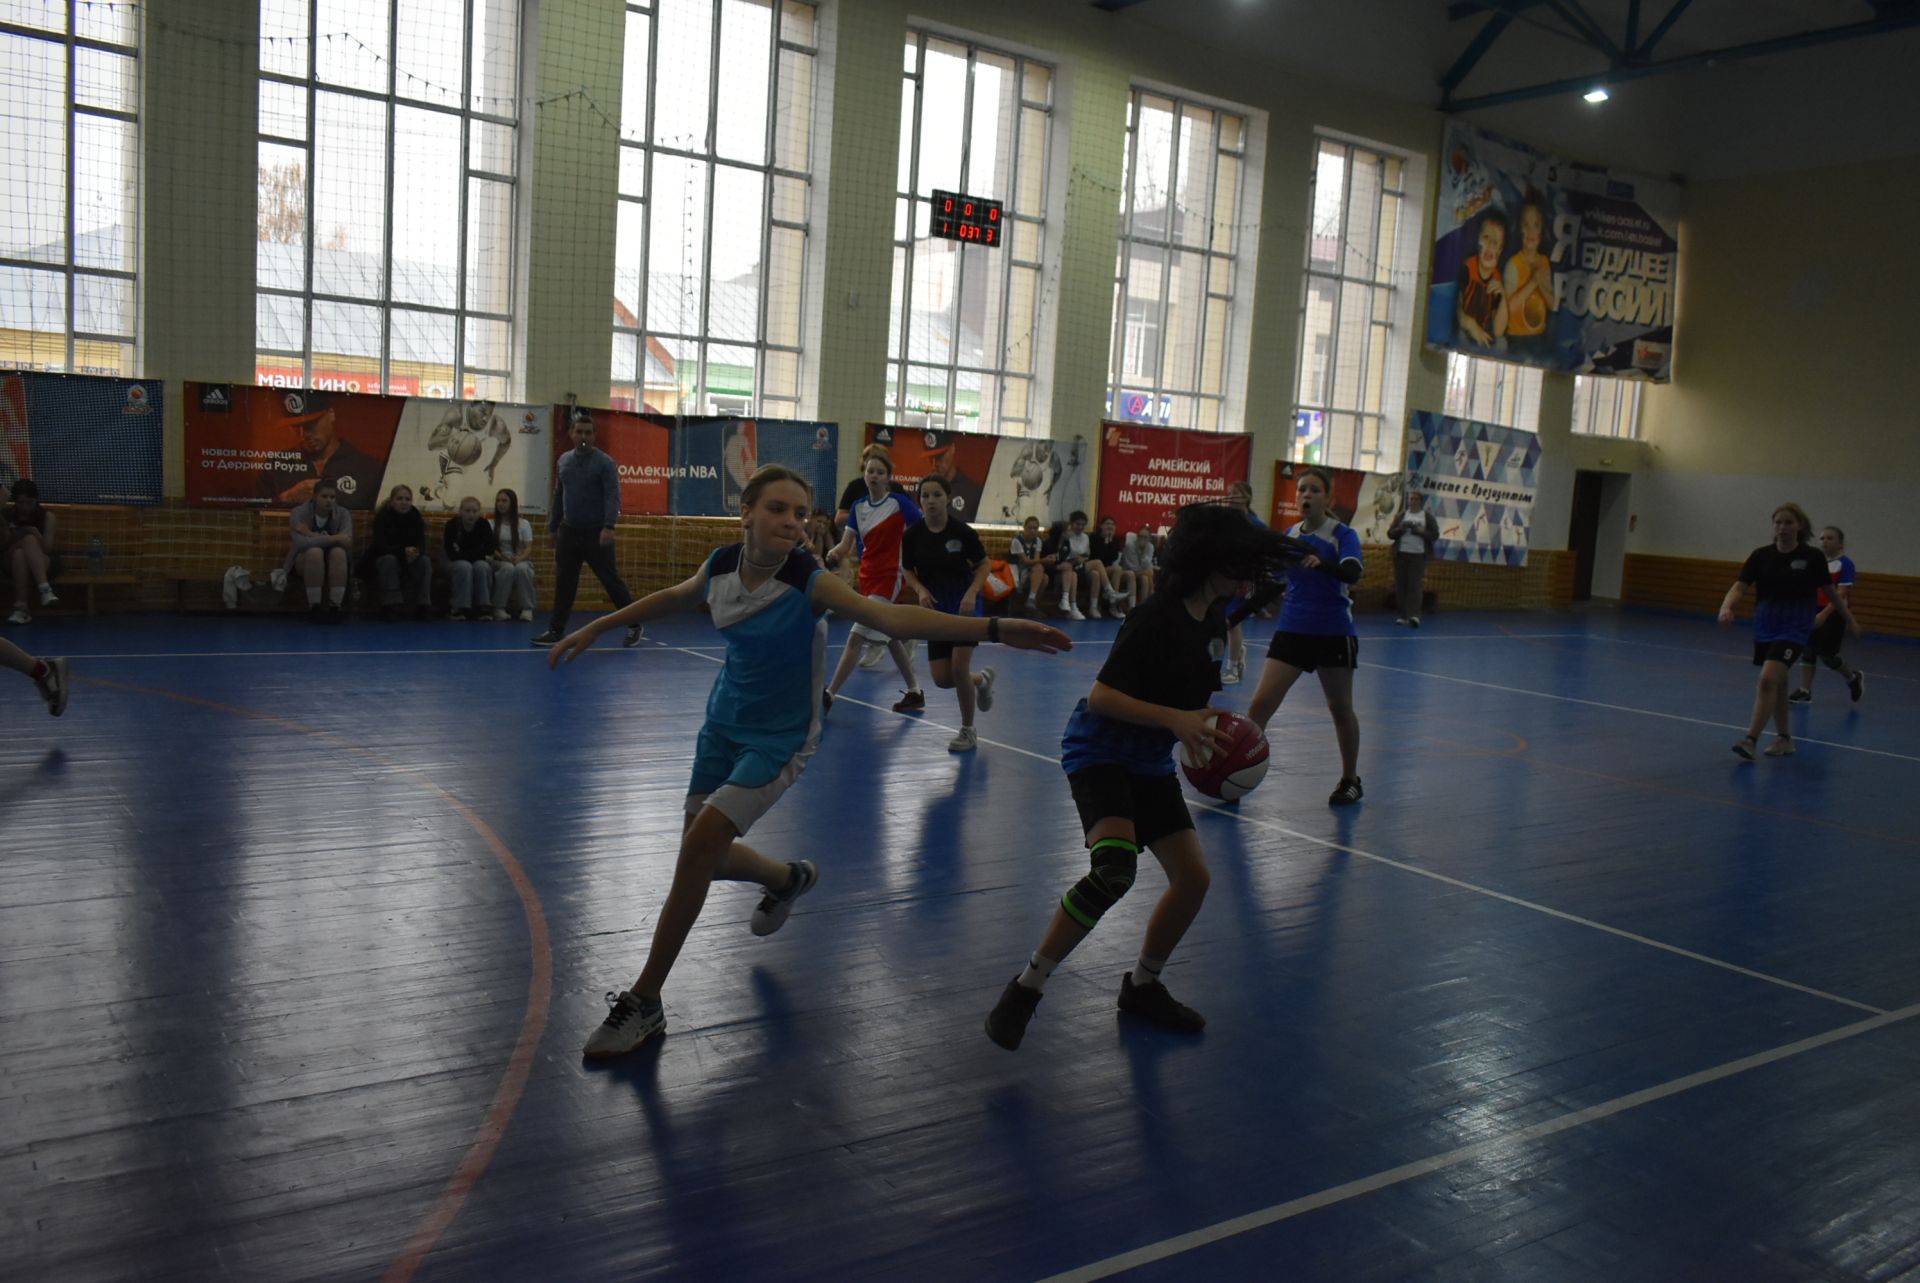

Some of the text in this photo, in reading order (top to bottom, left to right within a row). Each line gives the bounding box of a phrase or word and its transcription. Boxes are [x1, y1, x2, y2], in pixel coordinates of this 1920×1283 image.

[945, 200, 998, 221] 0 0 0
[987, 229, 994, 242] 3
[1551, 214, 1583, 266] Я
[1553, 269, 1674, 329] РОССИИ
[201, 448, 301, 460] новая коллекция
[201, 459, 307, 472] от Деррика Роуза
[616, 465, 718, 479] оллекция NBA
[1148, 457, 1210, 474] АРМЕЙСКИЙ
[1129, 474, 1224, 491] РУКОПАШНЫЙ БОЙ
[1424, 477, 1460, 493] Вместе
[1463, 486, 1469, 494] с
[1119, 490, 1133, 503] НА
[1135, 492, 1176, 505] СТРАЖЕ
[1784, 648, 1793, 660] 9
